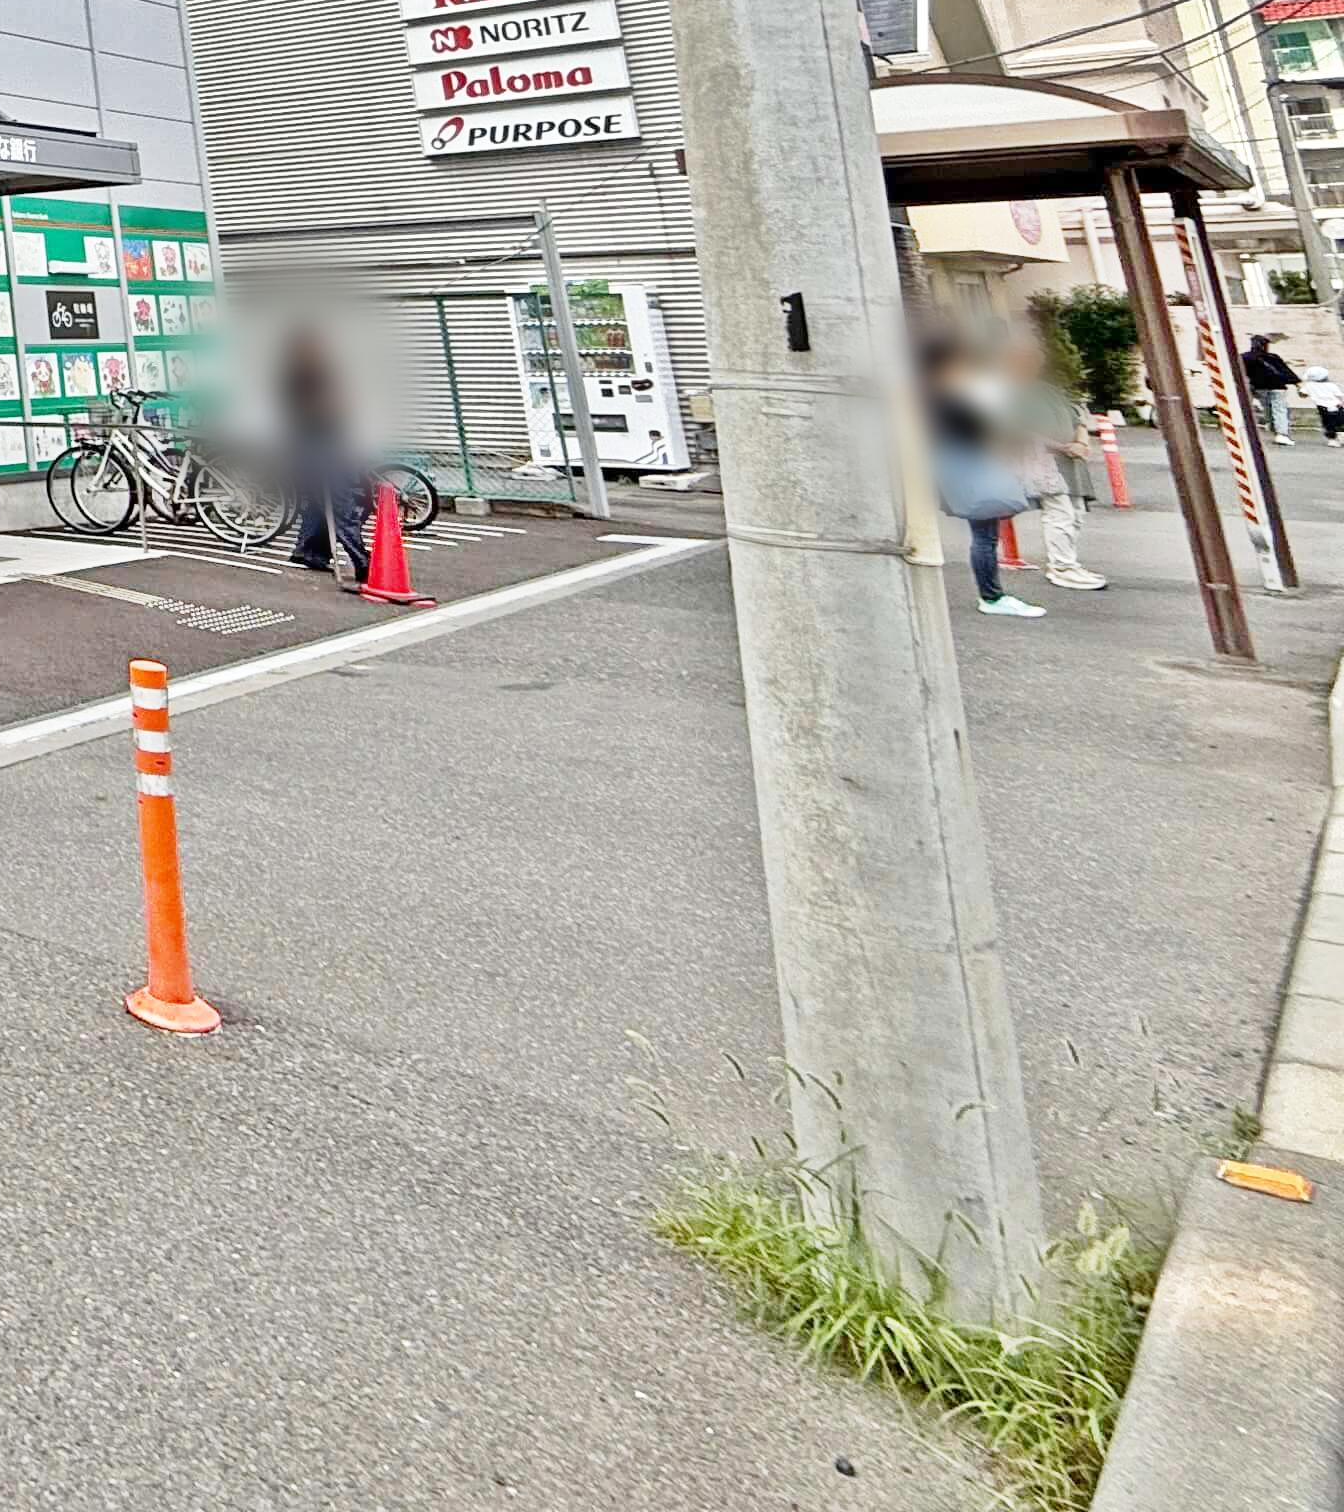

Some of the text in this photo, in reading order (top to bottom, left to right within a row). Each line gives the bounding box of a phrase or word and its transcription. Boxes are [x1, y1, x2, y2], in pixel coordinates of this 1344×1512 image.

[479, 11, 590, 44] NORITZ
[440, 65, 593, 101] Paloma
[467, 113, 623, 146] PURPOSE
